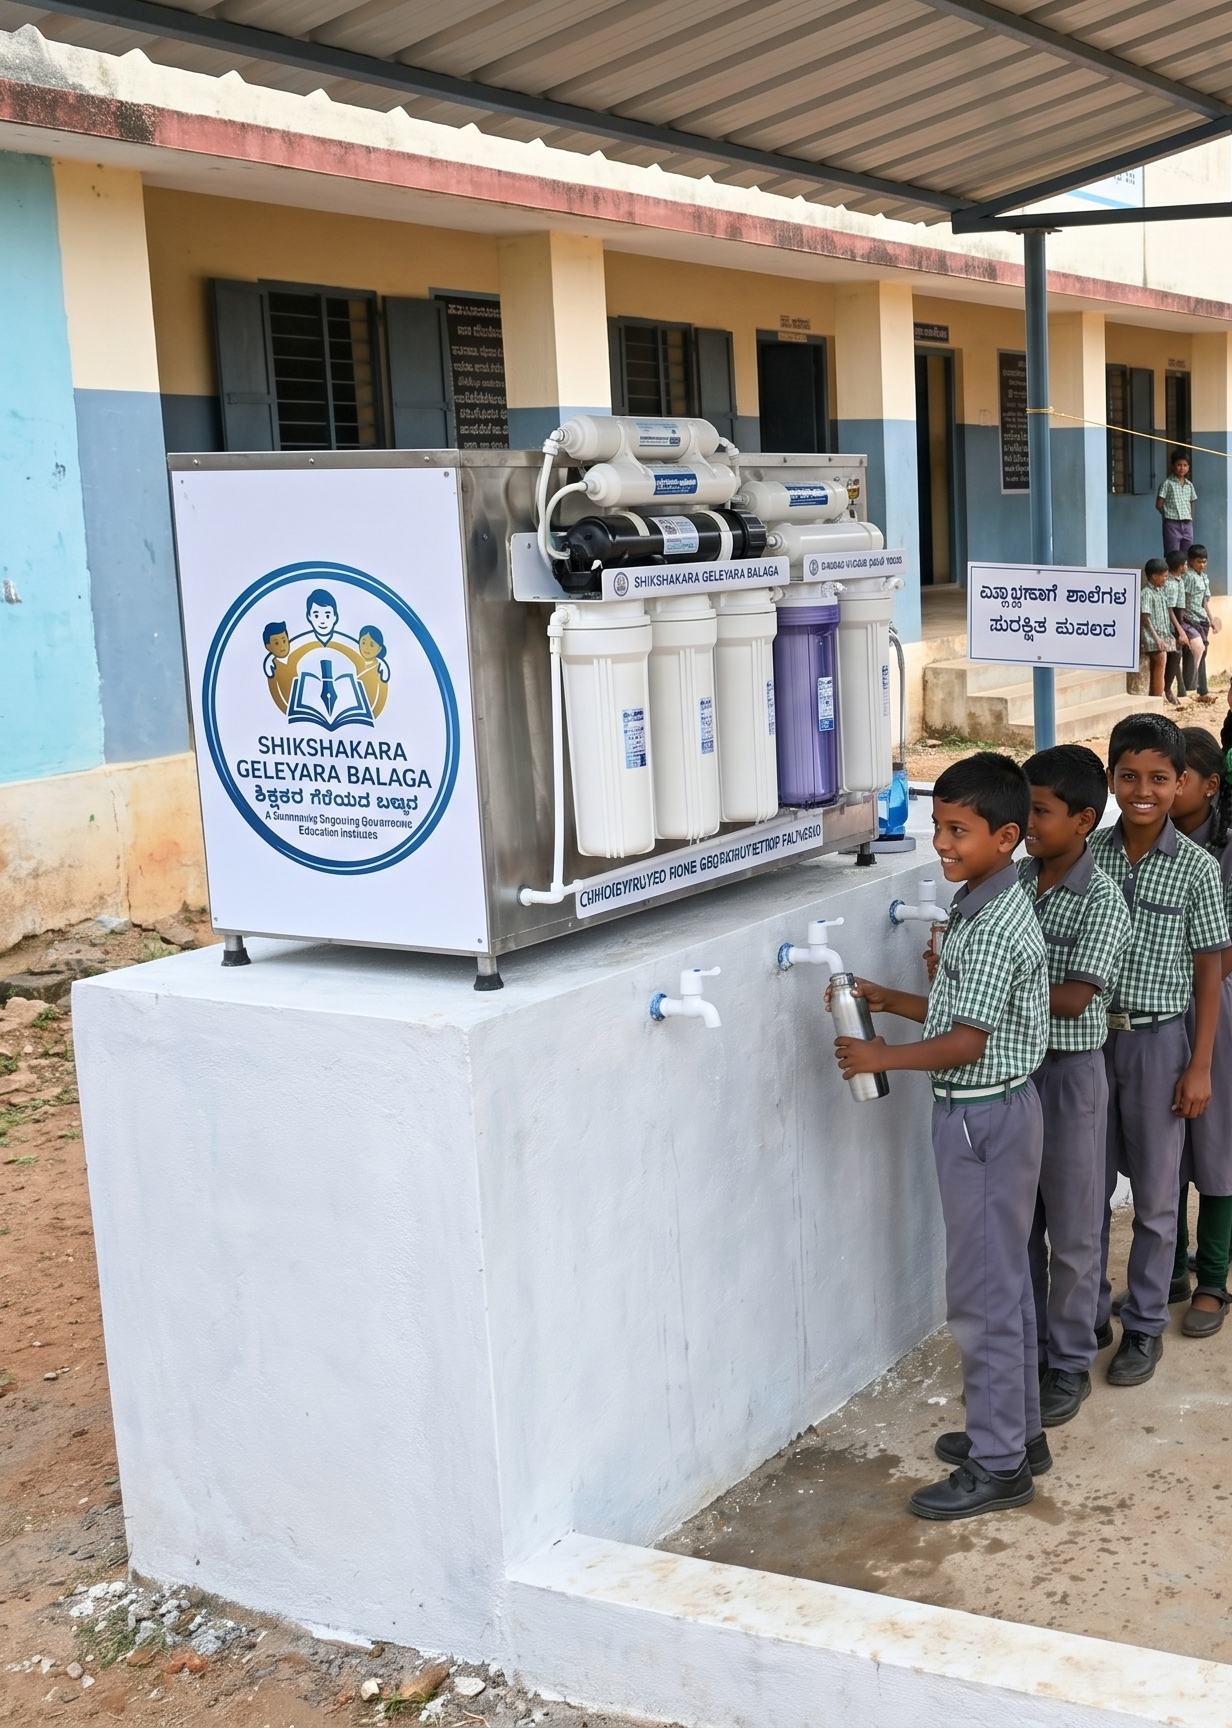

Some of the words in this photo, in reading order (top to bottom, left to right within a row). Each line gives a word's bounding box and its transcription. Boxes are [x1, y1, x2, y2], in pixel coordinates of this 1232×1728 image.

[634, 571, 700, 589] SHIKSHAKARA
[702, 567, 746, 583] GELEYARA
[747, 565, 779, 579] BALAGA
[257, 735, 408, 762] SHIKSHAKARA
[236, 759, 342, 784] GELEYARA
[346, 765, 433, 789] BALAGA
[265, 811, 272, 820] A
